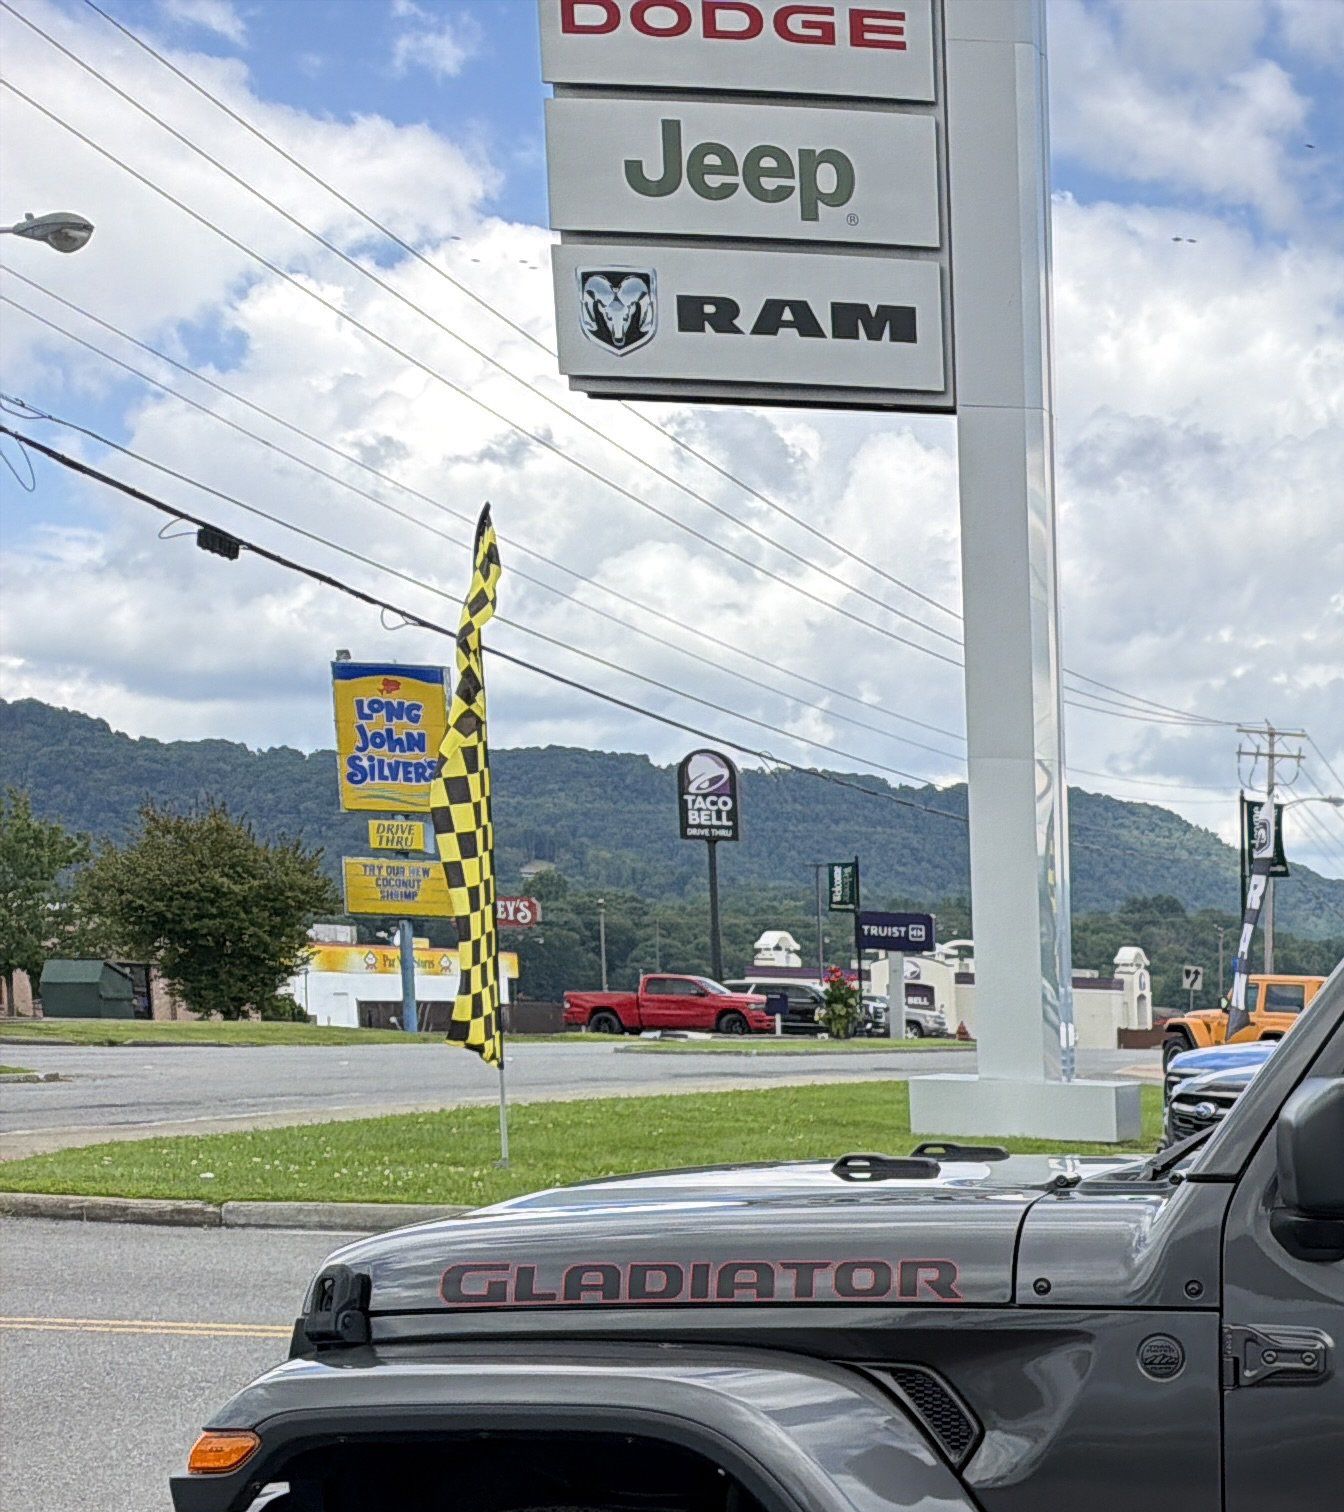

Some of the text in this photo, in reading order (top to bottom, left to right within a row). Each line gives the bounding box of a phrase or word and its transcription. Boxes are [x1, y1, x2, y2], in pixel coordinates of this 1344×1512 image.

[560, 0, 907, 50] DODGE
[624, 118, 856, 222] Jeep
[676, 294, 918, 344] RAM
[683, 794, 733, 811] TACO
[688, 810, 734, 826] BELL
[375, 822, 415, 837] DRIVE
[686, 827, 733, 838] DRIVE THRU
[376, 835, 415, 849] THRU
[363, 864, 384, 877] TRY
[386, 865, 406, 877] OUR
[375, 878, 422, 890] COCONUT
[496, 898, 532, 924] EY'S
[861, 924, 907, 938] TRUIST
[907, 996, 930, 1006] BELL
[440, 1259, 963, 1304] GLADIATOR
